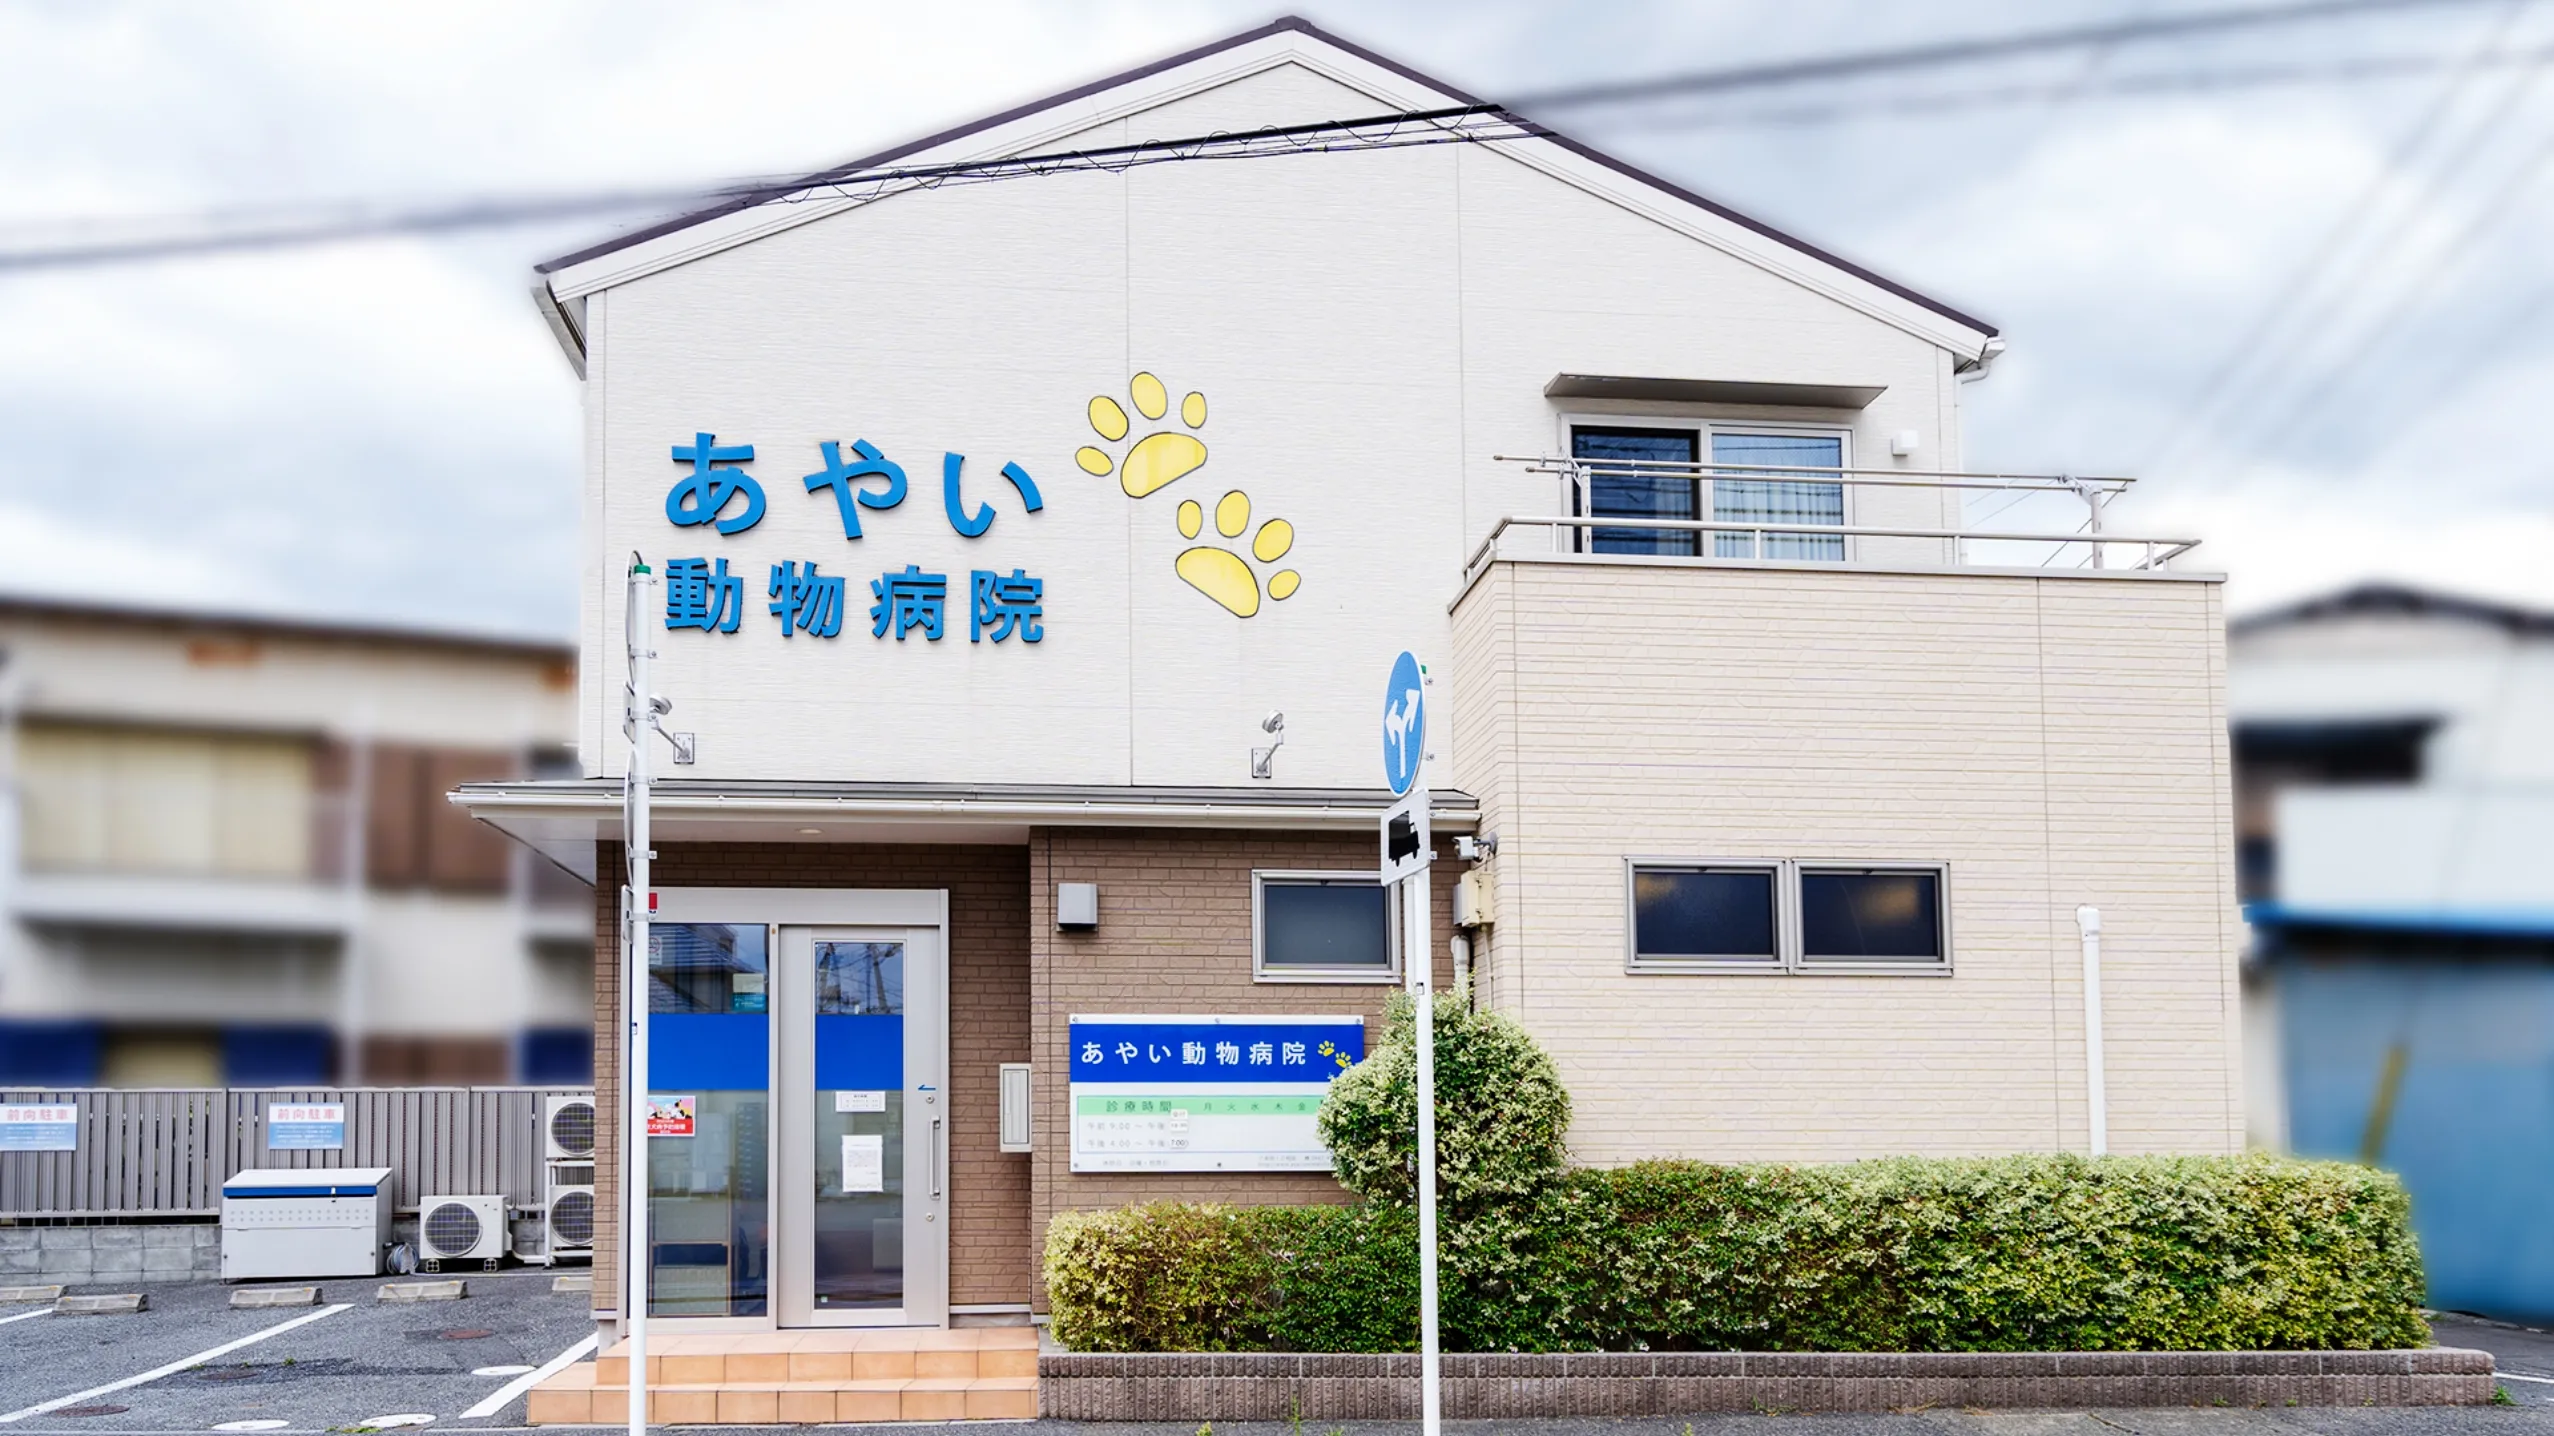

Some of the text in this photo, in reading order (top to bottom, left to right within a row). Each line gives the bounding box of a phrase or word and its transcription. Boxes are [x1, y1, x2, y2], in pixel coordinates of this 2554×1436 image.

[665, 432, 1044, 541] あやい
[665, 556, 1044, 644] 動物病院
[1081, 1041, 1306, 1066] あやい動物病院
[6, 1108, 69, 1121] 前向駐車
[277, 1107, 336, 1121] 前向駐車
[1106, 1100, 1172, 1113] 診療時間
[1203, 1102, 1212, 1111] 月
[1227, 1102, 1236, 1111] 火
[1250, 1102, 1259, 1111] 水
